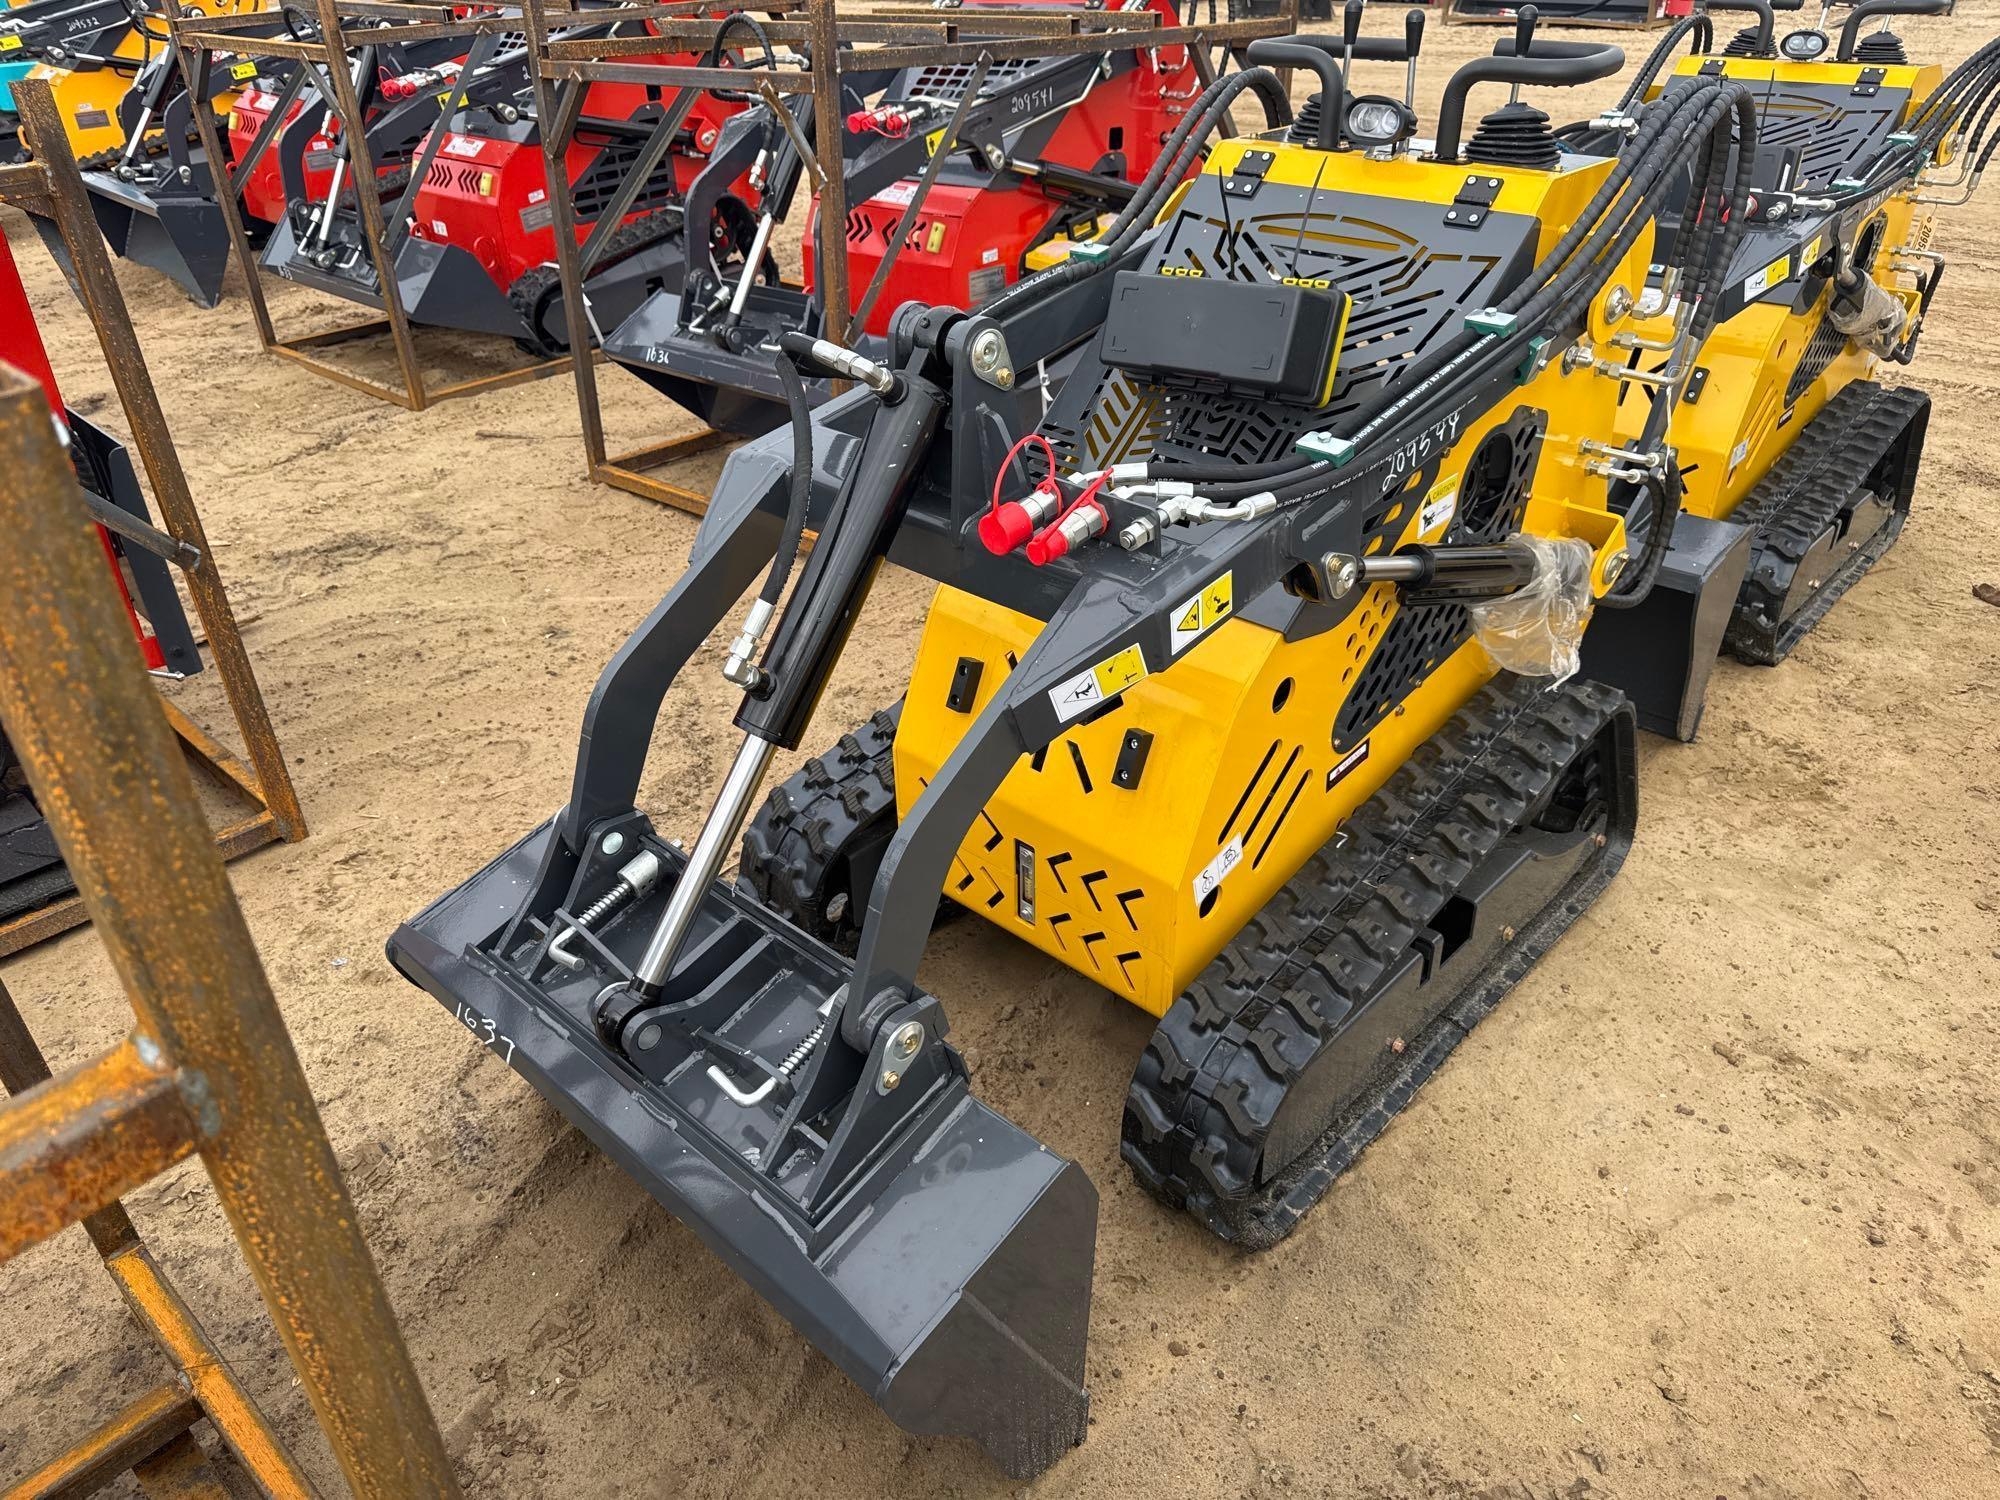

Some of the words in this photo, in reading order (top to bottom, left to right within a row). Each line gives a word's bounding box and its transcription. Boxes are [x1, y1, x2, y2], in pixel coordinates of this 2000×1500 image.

[1011, 86, 1053, 113] 209541
[1382, 411, 1460, 492] 209544
[1432, 481, 1456, 500] CAUTION
[456, 1001, 515, 1065] 1637
